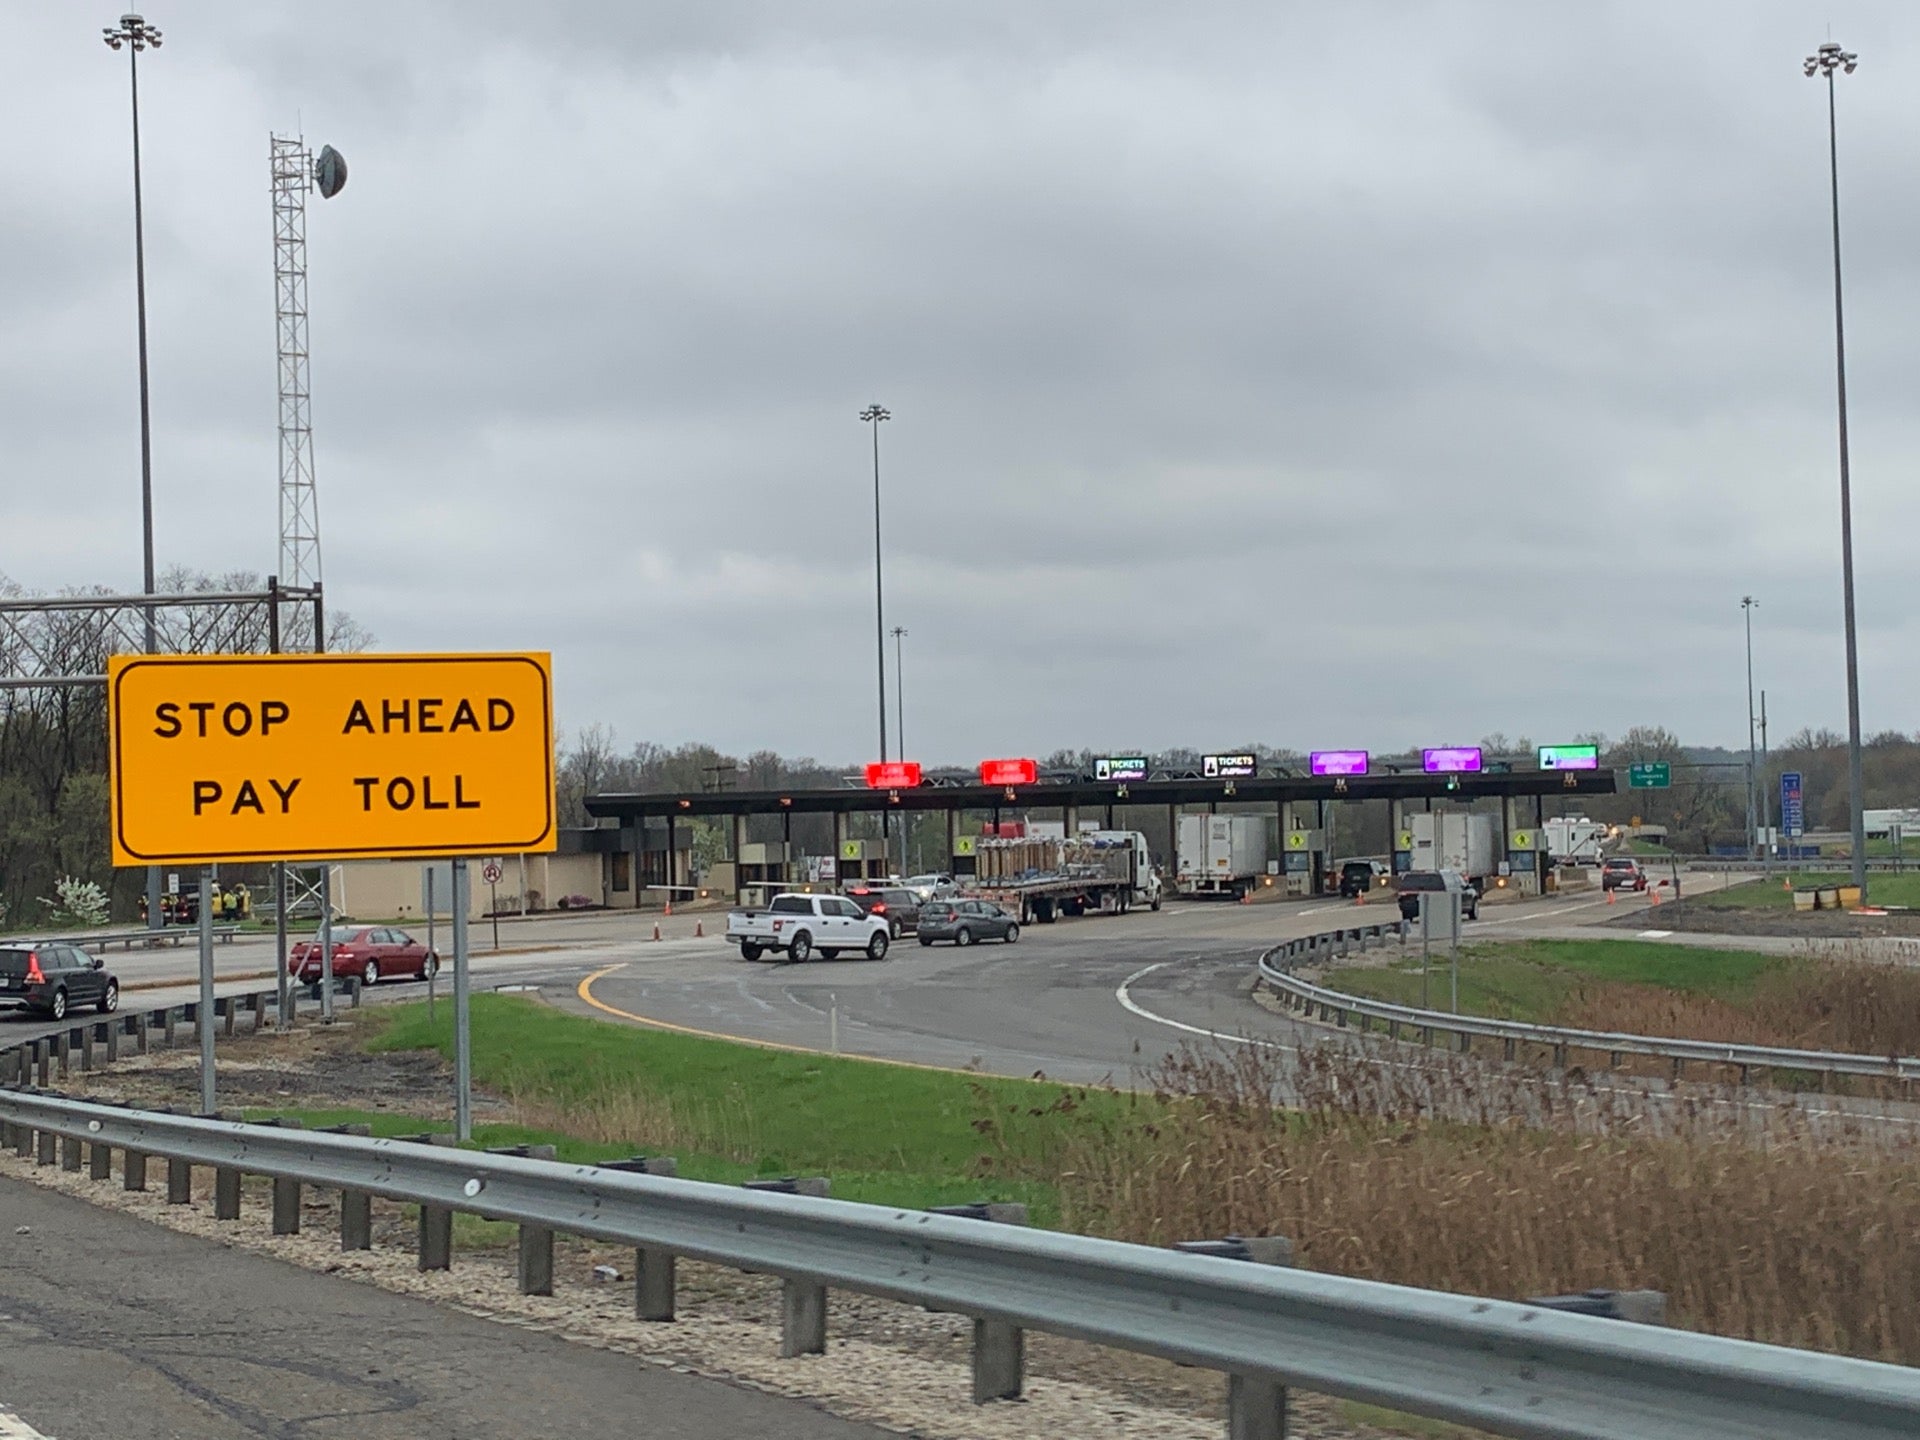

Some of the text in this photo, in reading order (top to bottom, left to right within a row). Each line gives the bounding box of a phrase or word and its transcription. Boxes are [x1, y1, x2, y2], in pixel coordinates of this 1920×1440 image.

[154, 699, 514, 738] STOP AHEAD
[1110, 759, 1145, 768] TICKETS
[1218, 756, 1254, 765] TICKETS
[194, 775, 480, 815] PAY TOLL
